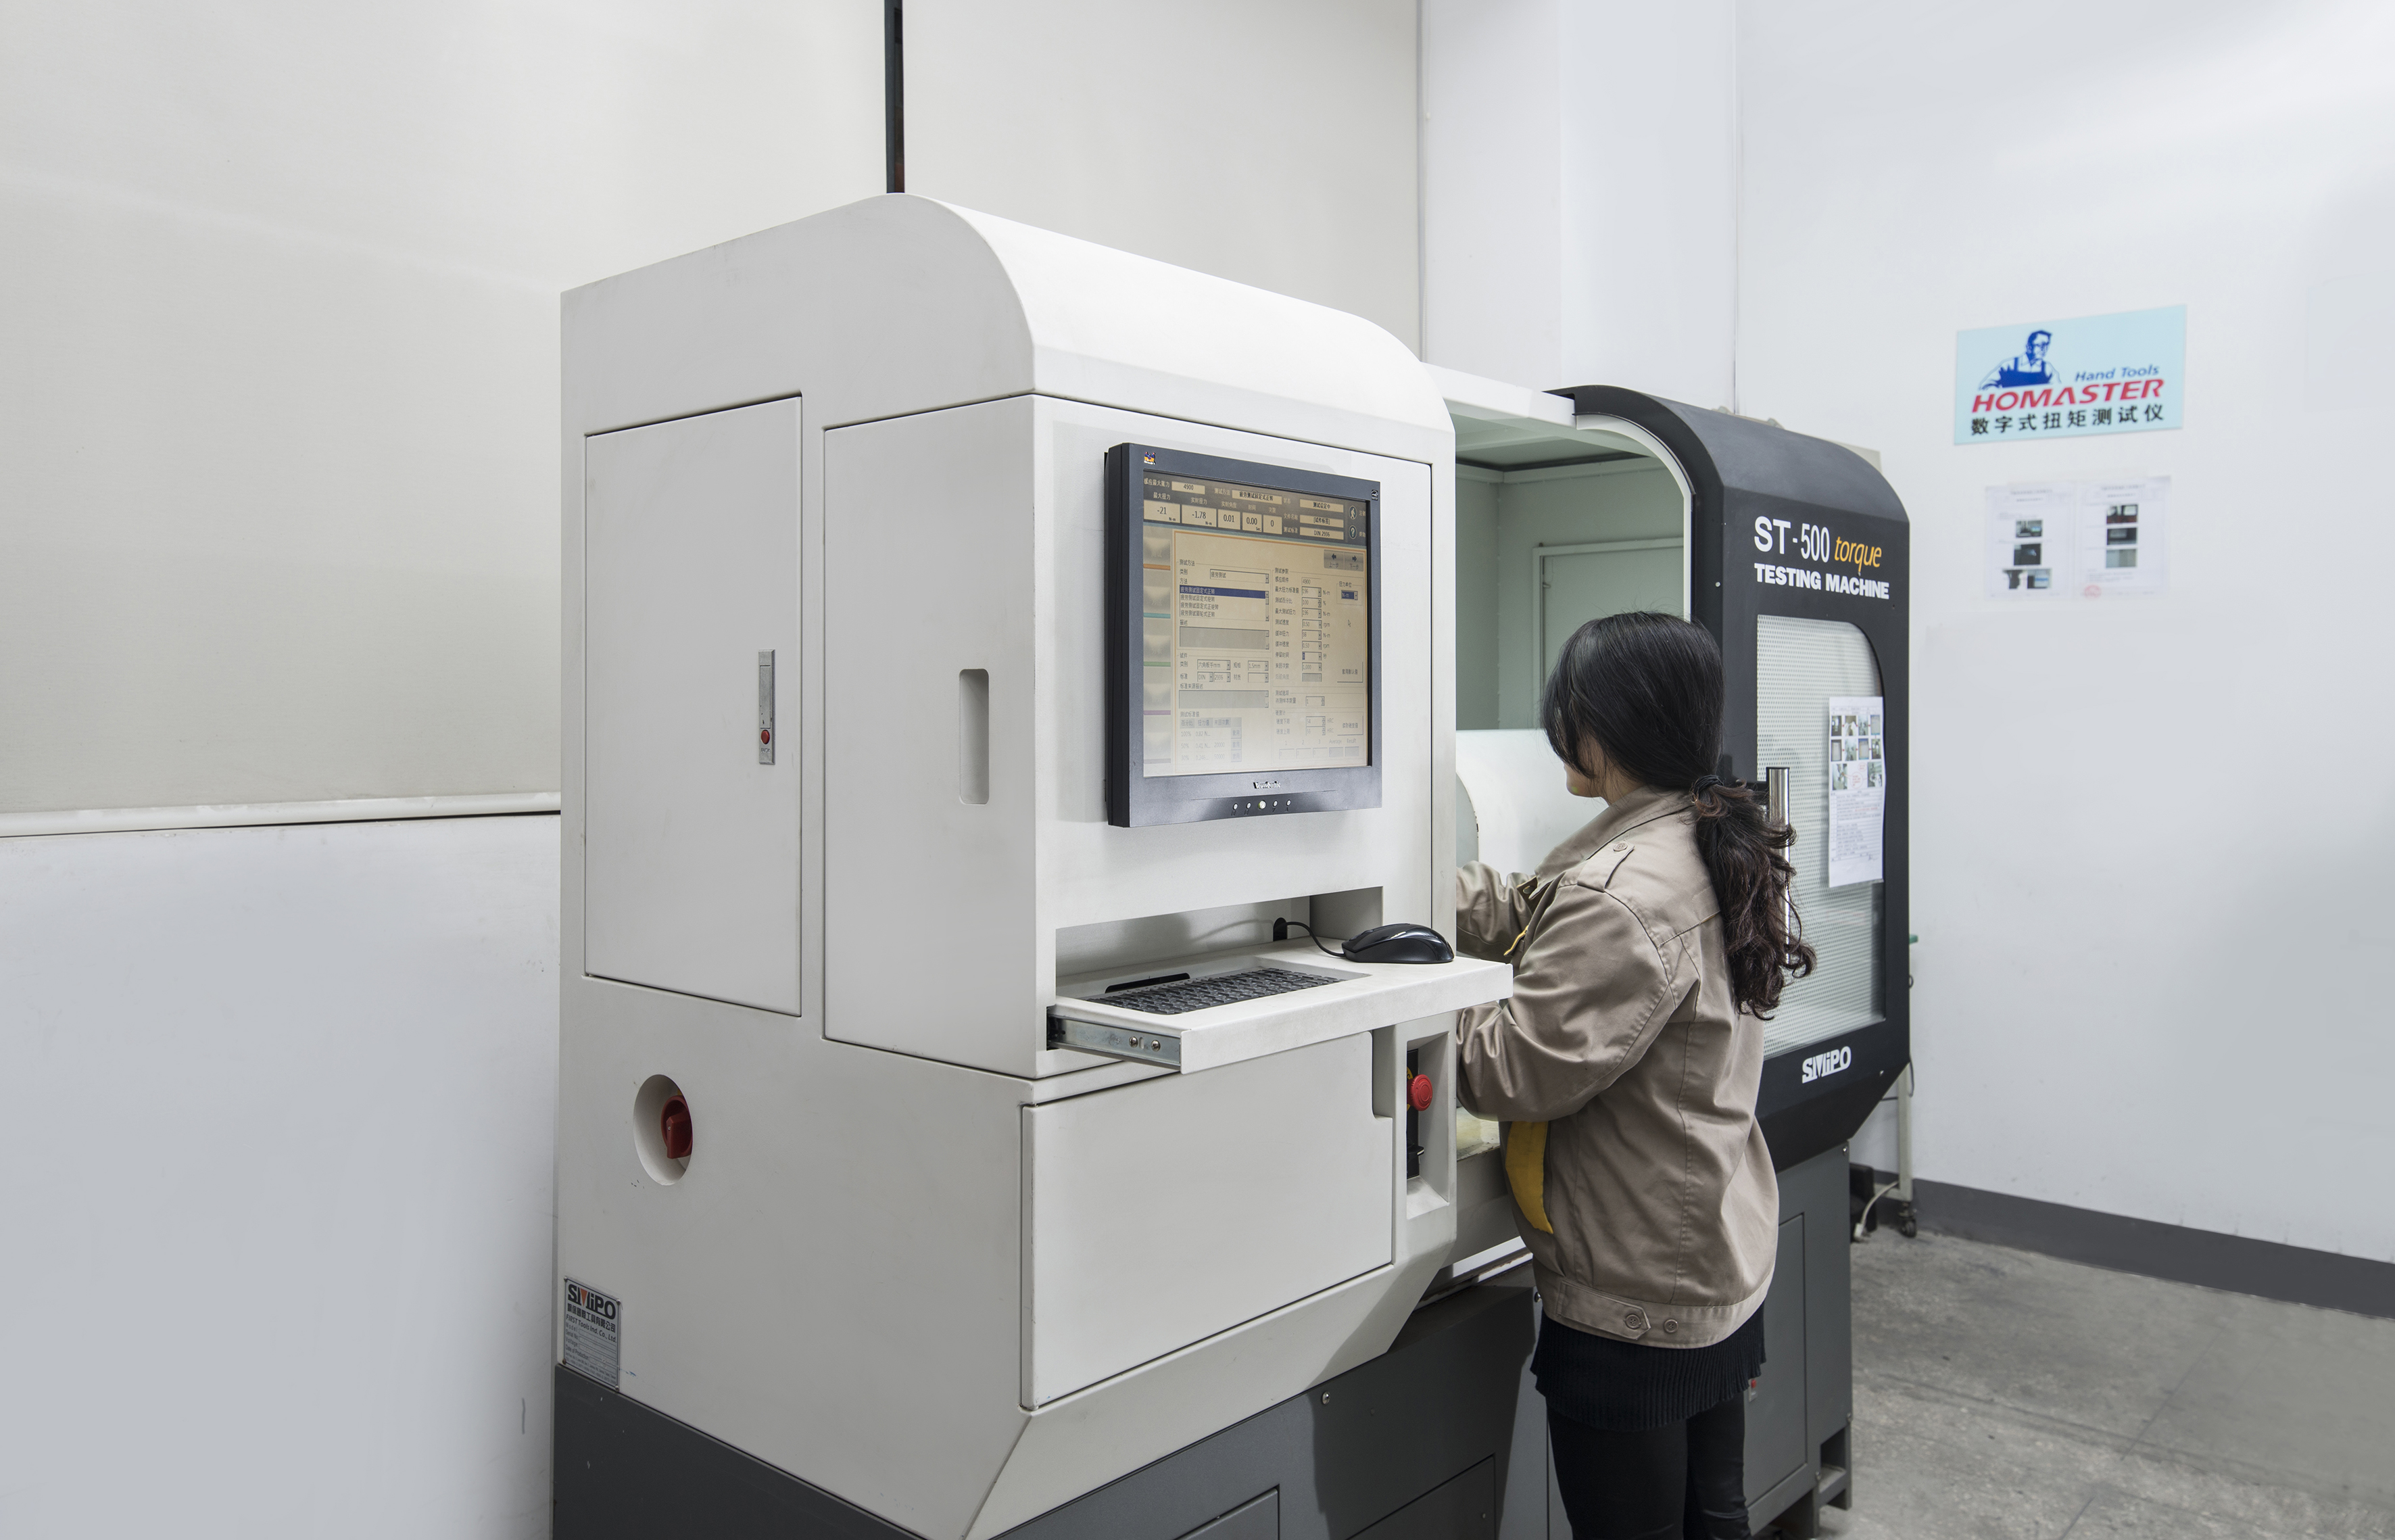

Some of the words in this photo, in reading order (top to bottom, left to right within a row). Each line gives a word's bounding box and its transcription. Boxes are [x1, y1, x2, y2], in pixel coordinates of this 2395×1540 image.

[2075, 368, 2115, 383] Hand
[2121, 364, 2160, 378] Tools
[1972, 379, 2164, 413] HOMASTER
[1971, 404, 2164, 435] 数字式扭矩测试仪
[1192, 510, 1206, 519] -1.78
[1224, 514, 1234, 523] 0.01
[1247, 517, 1257, 525] 0.00
[1835, 536, 1882, 573] torque
[1754, 562, 1822, 590] TESTING
[1825, 573, 1889, 600] MACHINE
[1253, 781, 1281, 789] ViewSonic
[566, 1314, 578, 1324] FIRST
[578, 1320, 589, 1330] Tools
[590, 1326, 598, 1334] Ind.
[608, 1334, 617, 1343] Ltd.
